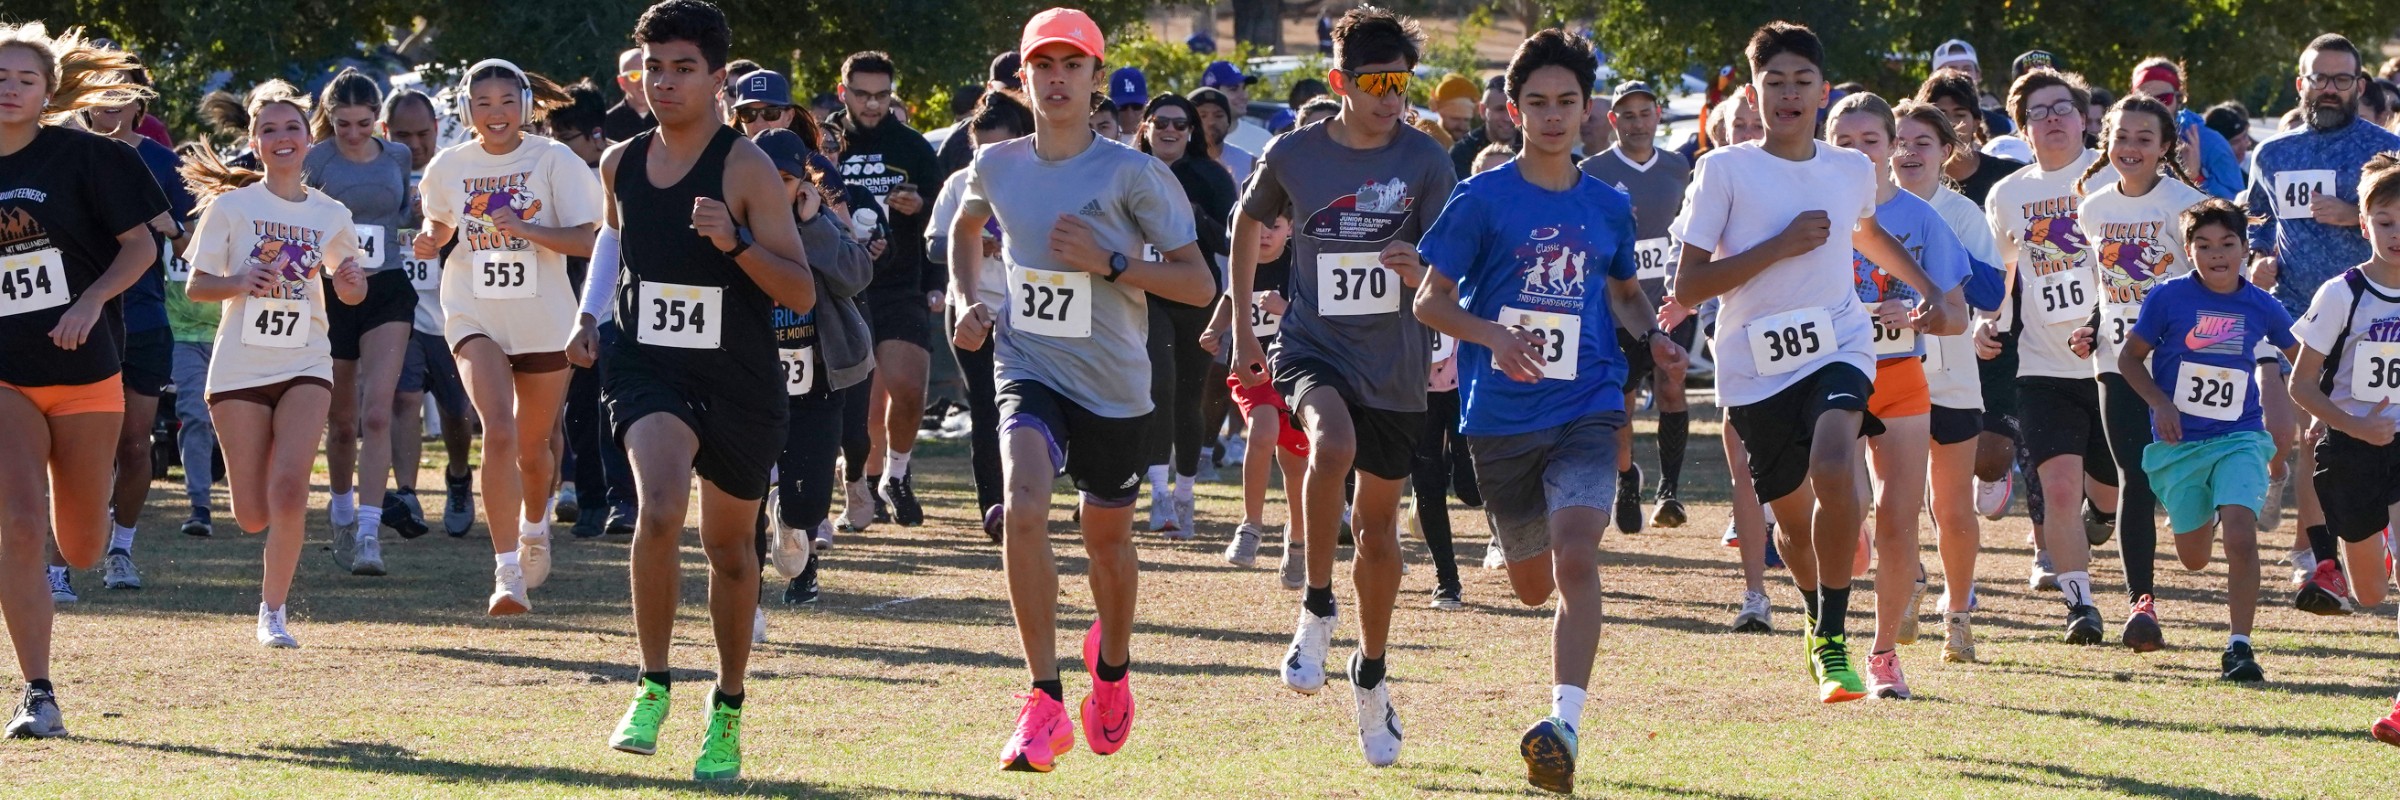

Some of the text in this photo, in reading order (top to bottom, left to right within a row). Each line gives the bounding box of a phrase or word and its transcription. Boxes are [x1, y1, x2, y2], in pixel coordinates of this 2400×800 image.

[1124, 78, 1135, 92] LA
[463, 171, 532, 194] TURKEY
[0, 187, 47, 203] OURTEENERS
[2022, 196, 2078, 219] TURKE
[254, 220, 325, 244] TURKEY
[1364, 217, 1392, 225] OLYMPIC
[467, 230, 511, 252] TROT
[1535, 242, 1560, 255] Classic
[405, 261, 428, 281] 38
[484, 262, 525, 288] 553
[2, 265, 51, 301] 454
[1332, 267, 1386, 301] 370
[2108, 283, 2142, 303] ROT
[1022, 283, 1074, 321] 327
[1517, 293, 1573, 307] INDEPENDENCE
[2042, 281, 2084, 312] 516
[255, 310, 300, 336] 457
[652, 298, 705, 334] 354
[2195, 315, 2238, 337] NIKE
[787, 324, 815, 340] MONTH
[1763, 321, 1820, 362] 385
[2367, 356, 2400, 389] 36
[2187, 376, 2234, 408] 329
